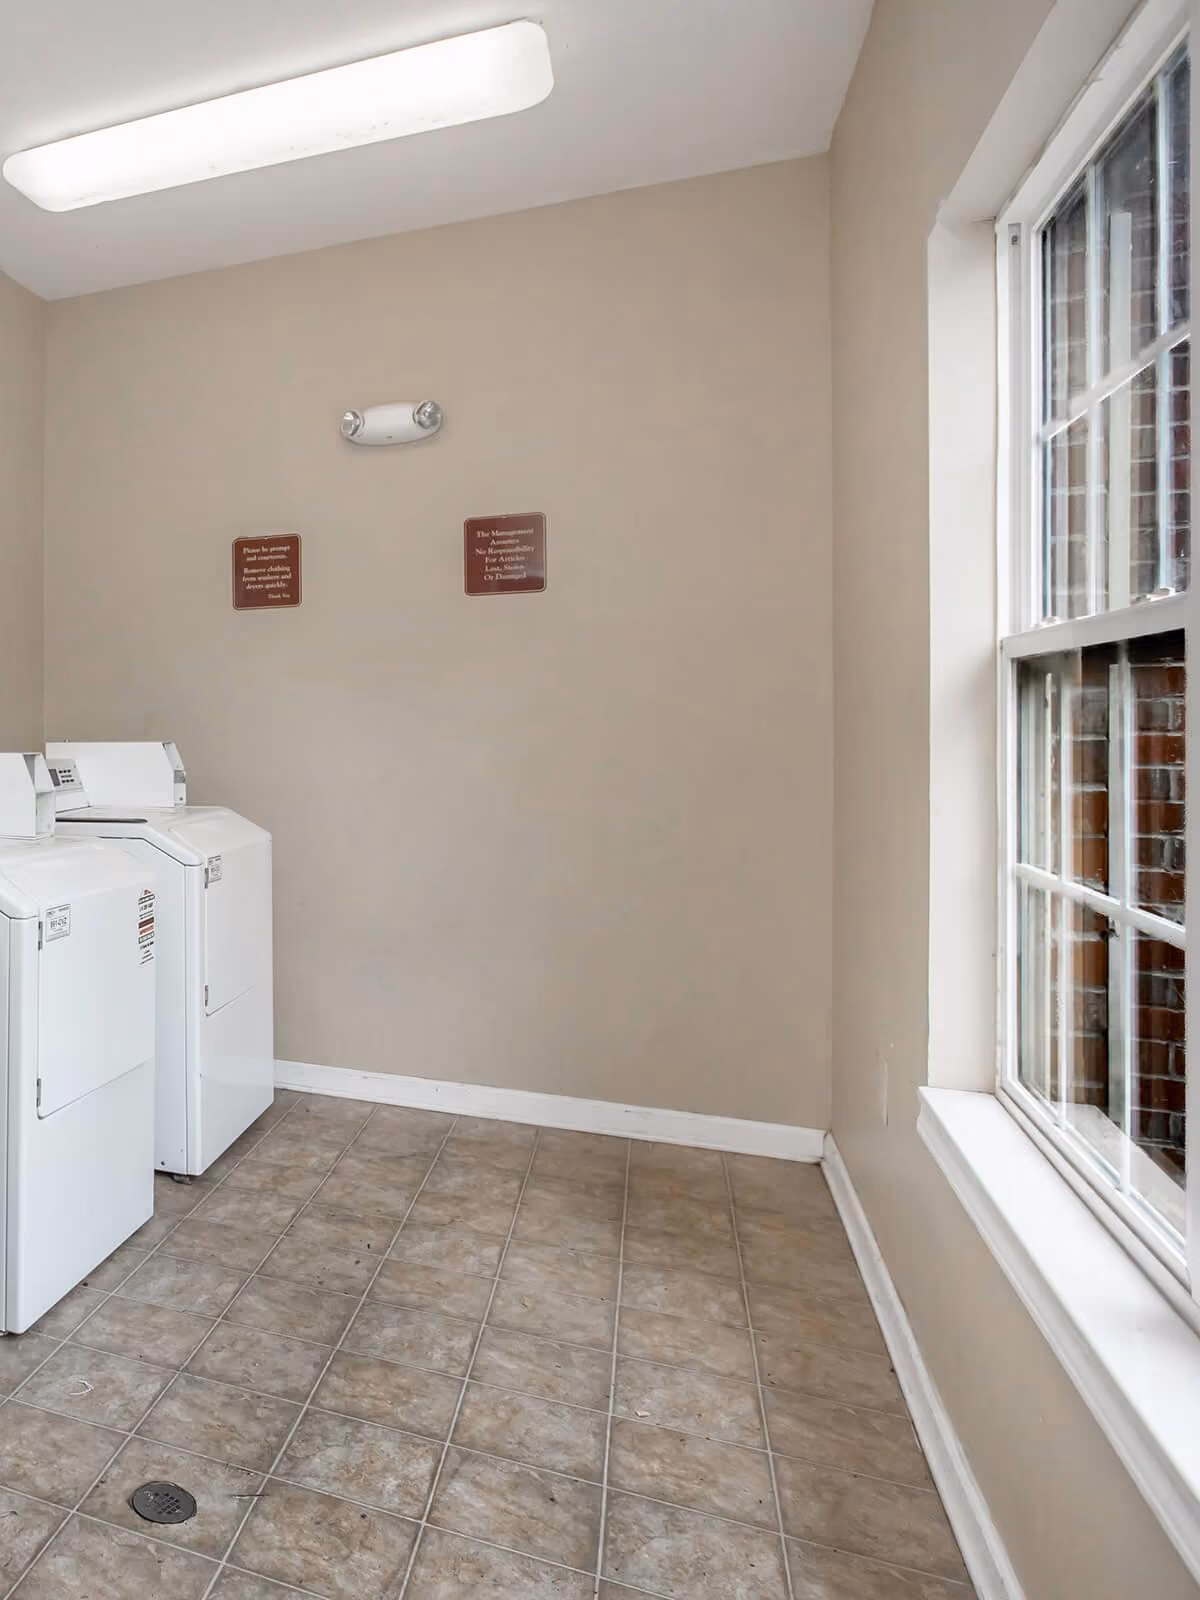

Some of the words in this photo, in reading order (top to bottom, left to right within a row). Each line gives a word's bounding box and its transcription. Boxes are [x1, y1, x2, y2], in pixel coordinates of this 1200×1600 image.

[476, 530, 490, 538] The
[491, 528, 534, 537] Management
[270, 545, 291, 553] prompt
[488, 545, 535, 555] Responsibility
[485, 556, 497, 564] For
[498, 554, 525, 562] Articles
[267, 565, 291, 573] clothing
[504, 563, 525, 571] Stolen
[495, 571, 527, 580] Damaged
